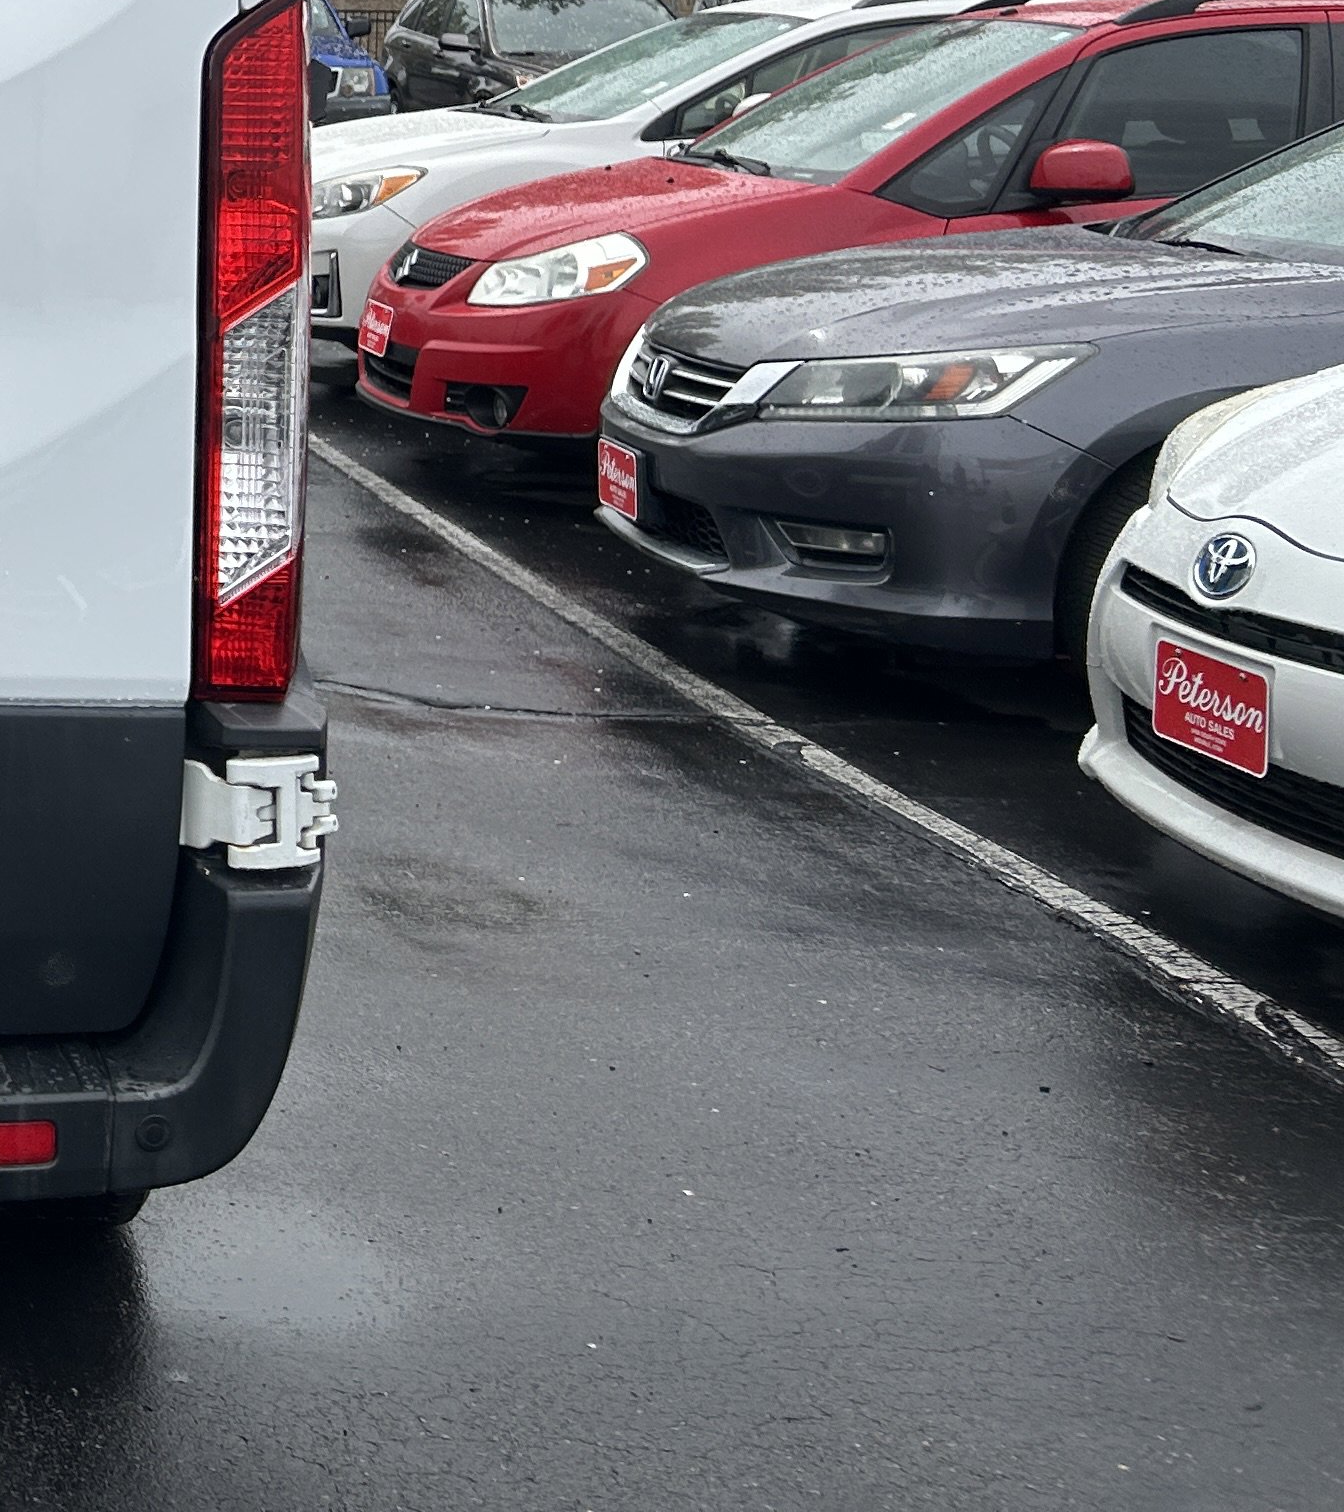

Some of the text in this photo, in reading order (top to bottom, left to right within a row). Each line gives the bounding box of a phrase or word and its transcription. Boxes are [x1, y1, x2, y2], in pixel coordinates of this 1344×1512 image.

[1158, 656, 1264, 733] Peterson
[1185, 712, 1207, 728] AUTO
[1208, 720, 1235, 740] SALES
